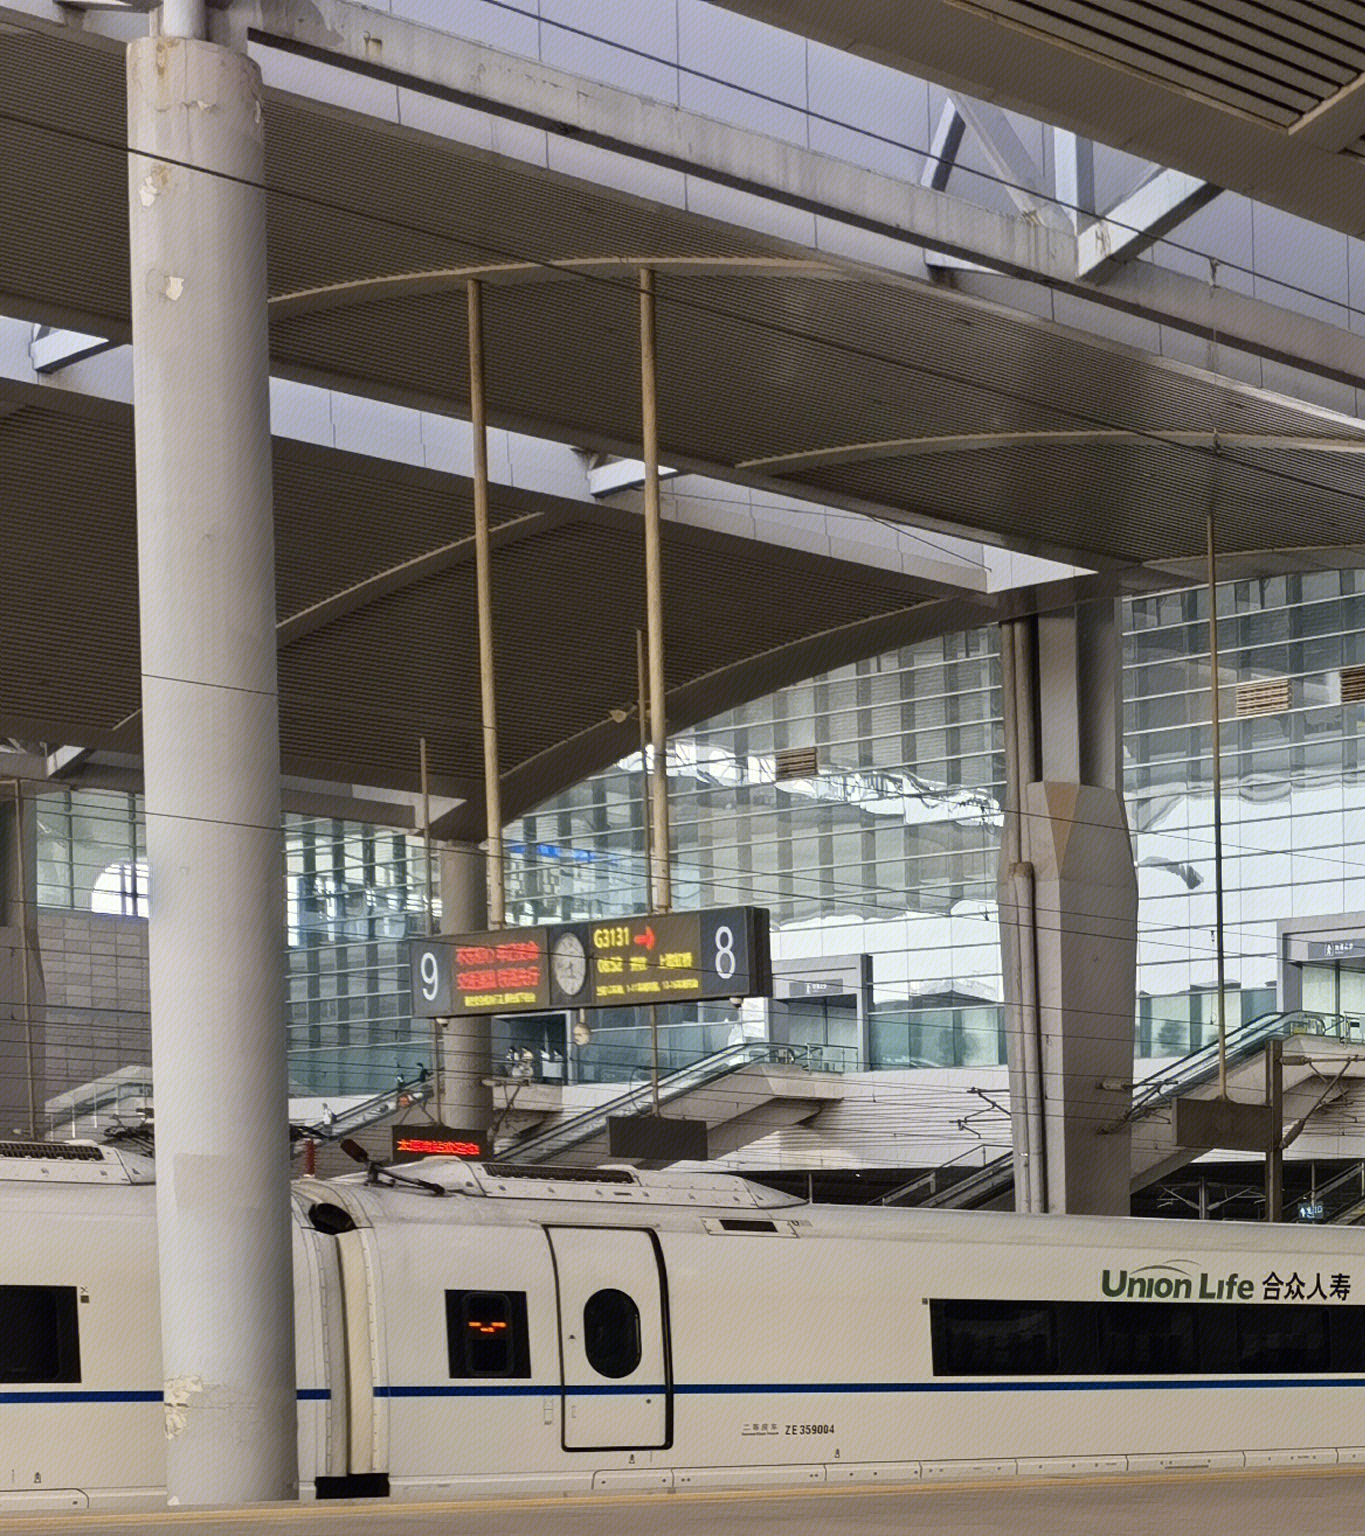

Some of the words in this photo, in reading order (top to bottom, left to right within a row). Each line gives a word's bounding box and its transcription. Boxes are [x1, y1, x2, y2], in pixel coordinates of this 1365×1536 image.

[593, 927, 629, 948] G3131
[715, 925, 736, 979] 8
[421, 952, 438, 1001] 9
[1101, 1268, 1192, 1299] Union
[1199, 1273, 1254, 1300] Life
[1262, 1271, 1352, 1301] 合众人寿
